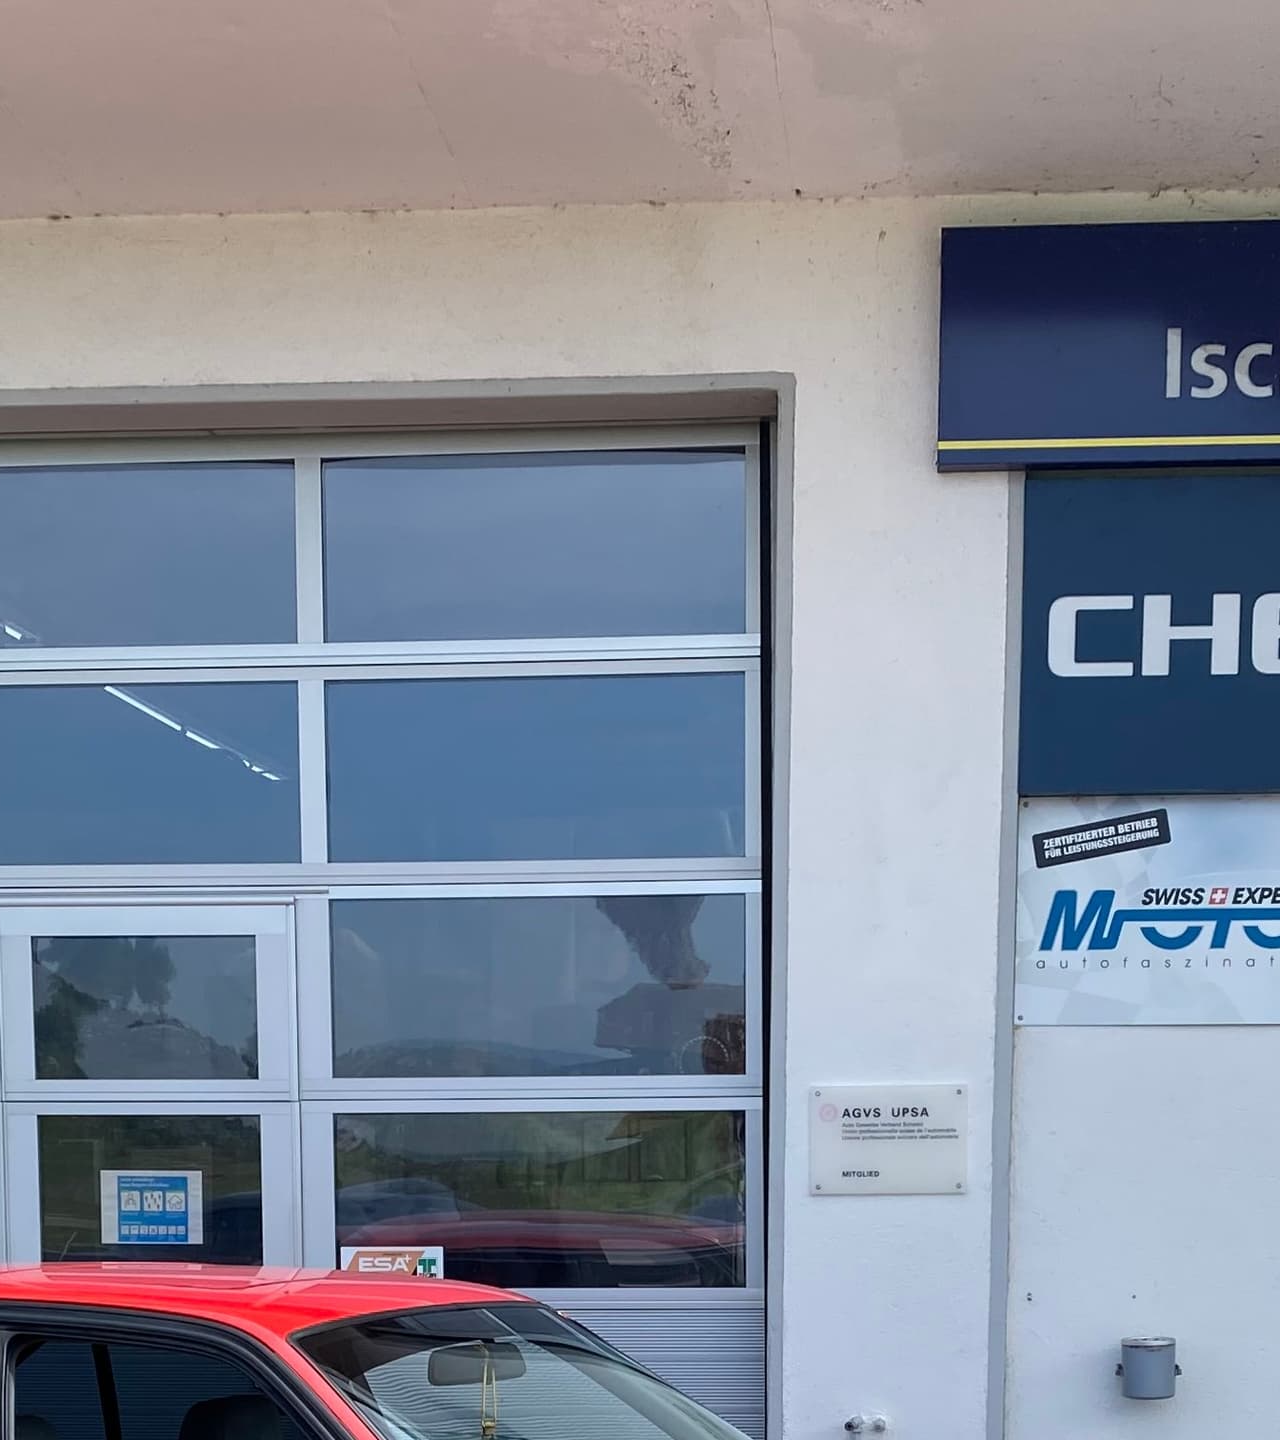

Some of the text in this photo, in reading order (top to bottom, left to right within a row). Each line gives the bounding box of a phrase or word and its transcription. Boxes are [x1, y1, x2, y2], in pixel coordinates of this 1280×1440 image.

[1042, 817, 1159, 850] ZERTIFIZIERTER BETRIEB
[1044, 828, 1160, 860] FÜR LEISTUNGSSTEIGERUNG
[1140, 887, 1206, 907] SWISS
[841, 1107, 929, 1118] AGVS UPSA
[841, 1170, 880, 1178] MITGLIED
